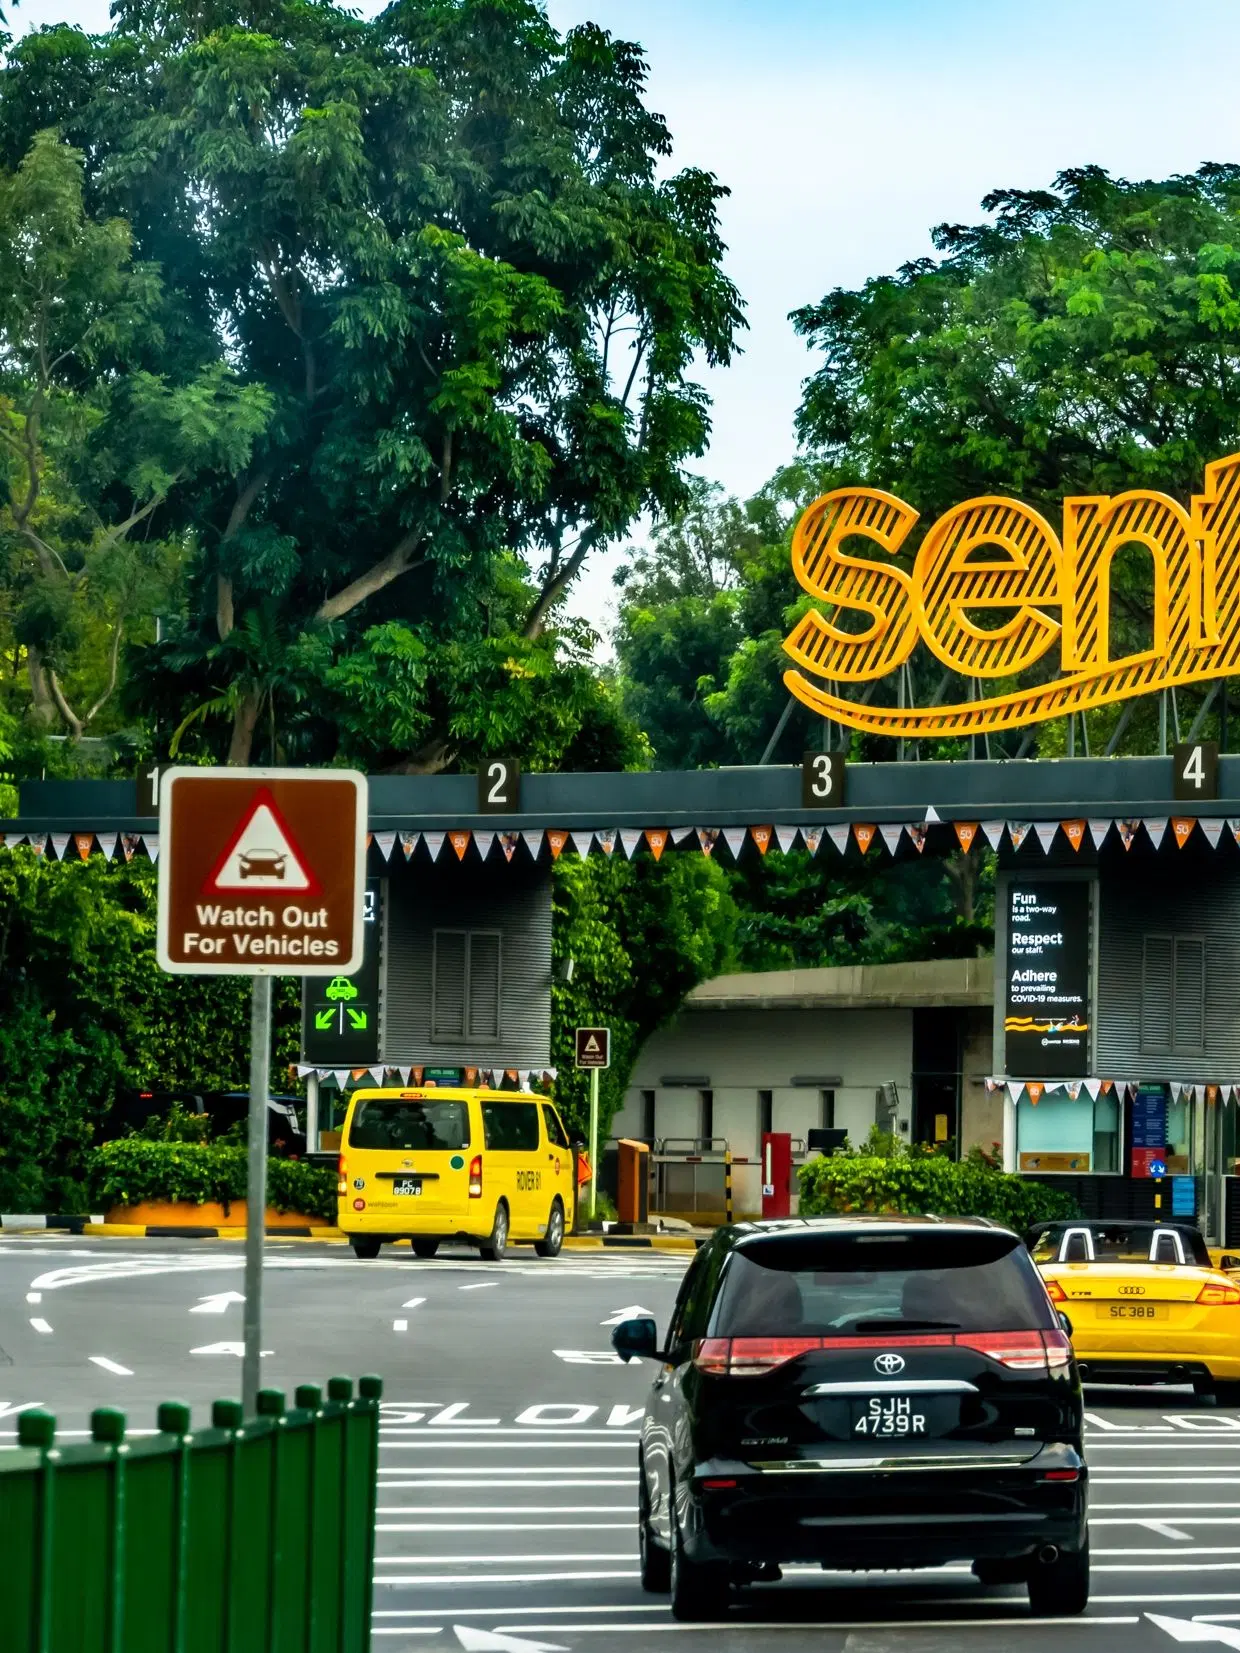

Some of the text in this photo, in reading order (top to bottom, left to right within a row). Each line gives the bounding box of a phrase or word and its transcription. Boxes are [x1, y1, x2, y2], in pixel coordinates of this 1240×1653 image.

[1183, 746, 1205, 789] 4
[487, 762, 507, 803] 2
[811, 755, 832, 797] 3
[147, 766, 159, 806] 1
[1012, 893, 1036, 904] Fun
[197, 905, 328, 928] Watch Out
[1012, 905, 1018, 913] is
[1025, 906, 1056, 914] two-way
[1012, 914, 1031, 922] road.
[183, 933, 340, 957] For Vehicles
[1012, 932, 1062, 946] Respect
[1025, 946, 1043, 954] staff.
[1011, 969, 1057, 982] Adhere
[1011, 984, 1056, 993] to prevailing
[1011, 995, 1082, 1003] COVID-19 measures.
[402, 1180, 413, 1188] PC
[516, 1170, 535, 1191] ROVER
[869, 1398, 911, 1415] SJH
[855, 1415, 925, 1434] 4739R
